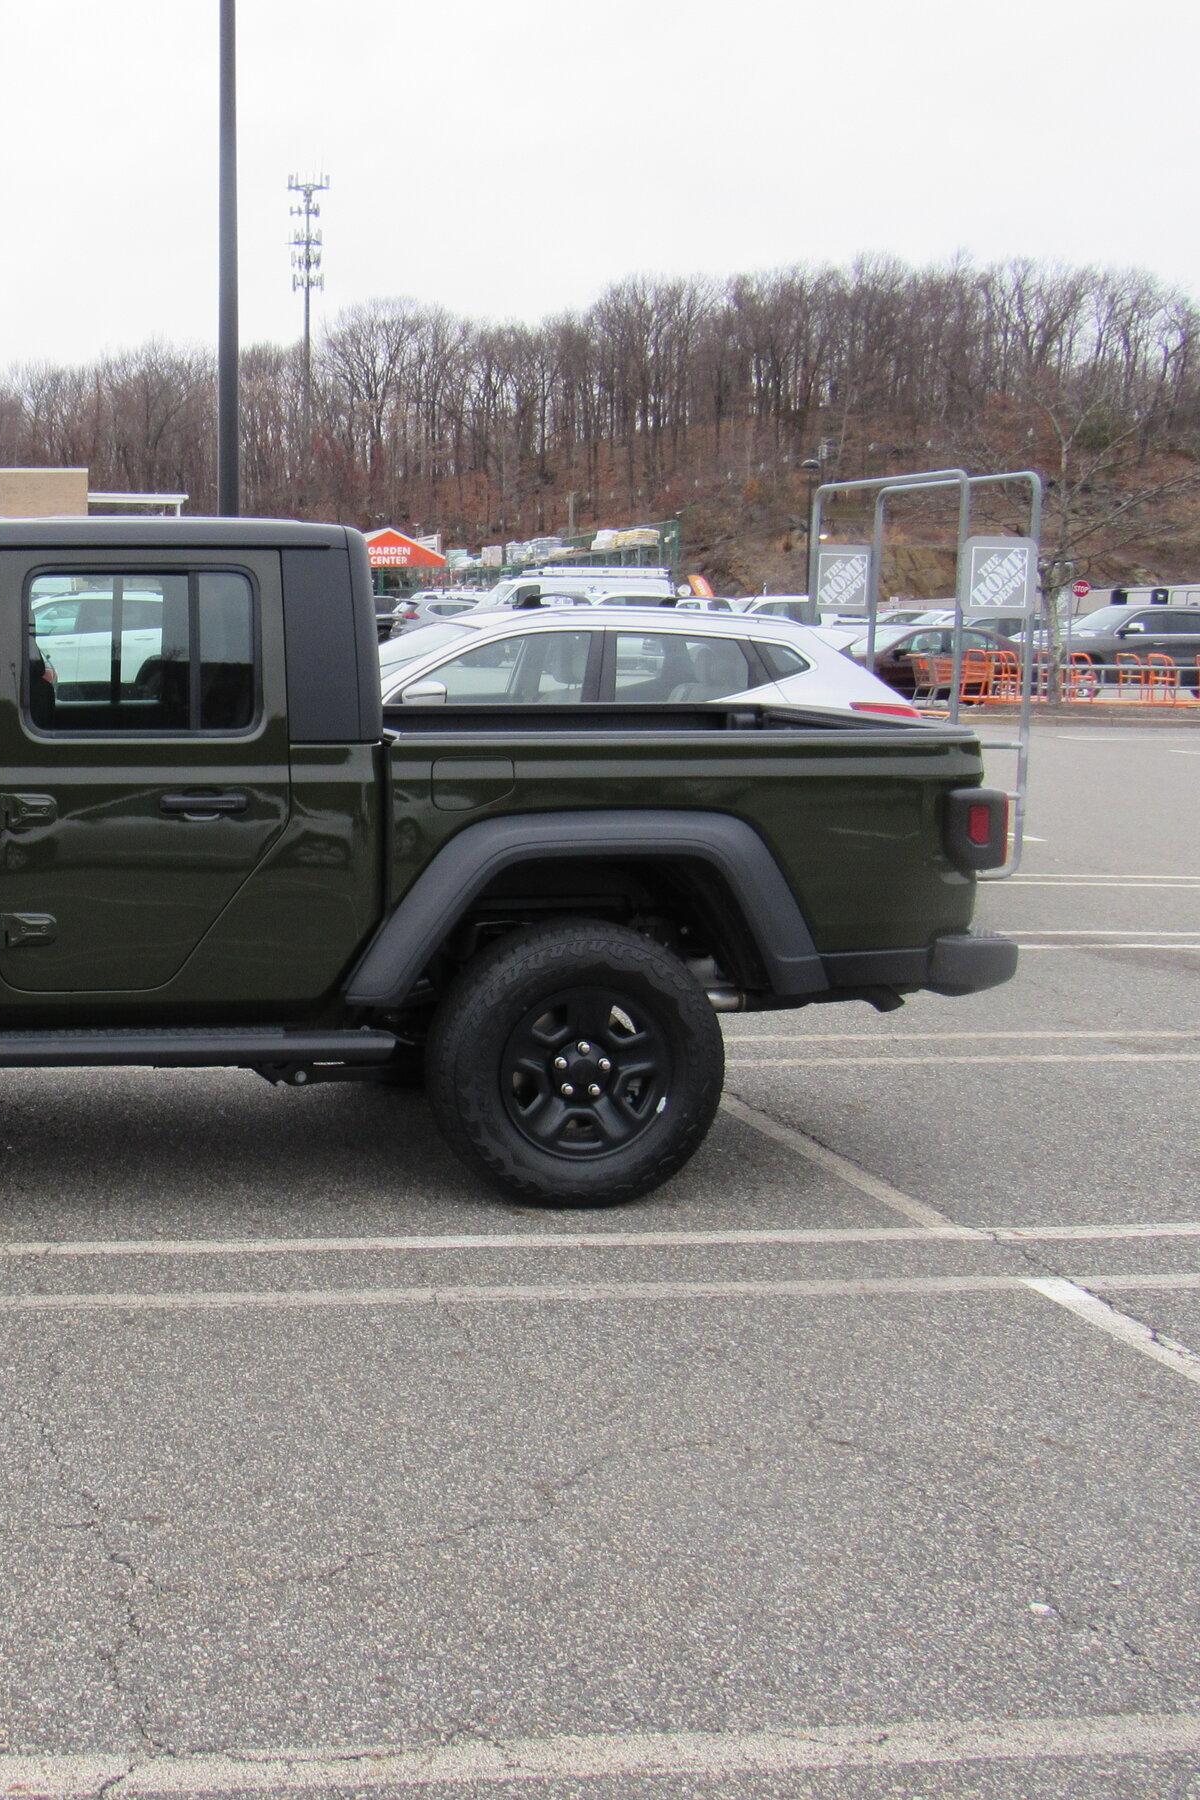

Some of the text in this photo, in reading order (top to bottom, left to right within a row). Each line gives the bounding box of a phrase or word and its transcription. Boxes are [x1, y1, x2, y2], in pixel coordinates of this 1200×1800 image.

[367, 546, 411, 556] GARDEN
[370, 556, 408, 565] CENTER
[823, 559, 846, 579] THE
[970, 549, 1027, 606] HOME
[976, 553, 1002, 578] THE
[817, 554, 867, 604] HOME
[836, 573, 867, 604] DEPOT
[991, 569, 1027, 606] DEPOT
[1072, 585, 1090, 593] STOP
